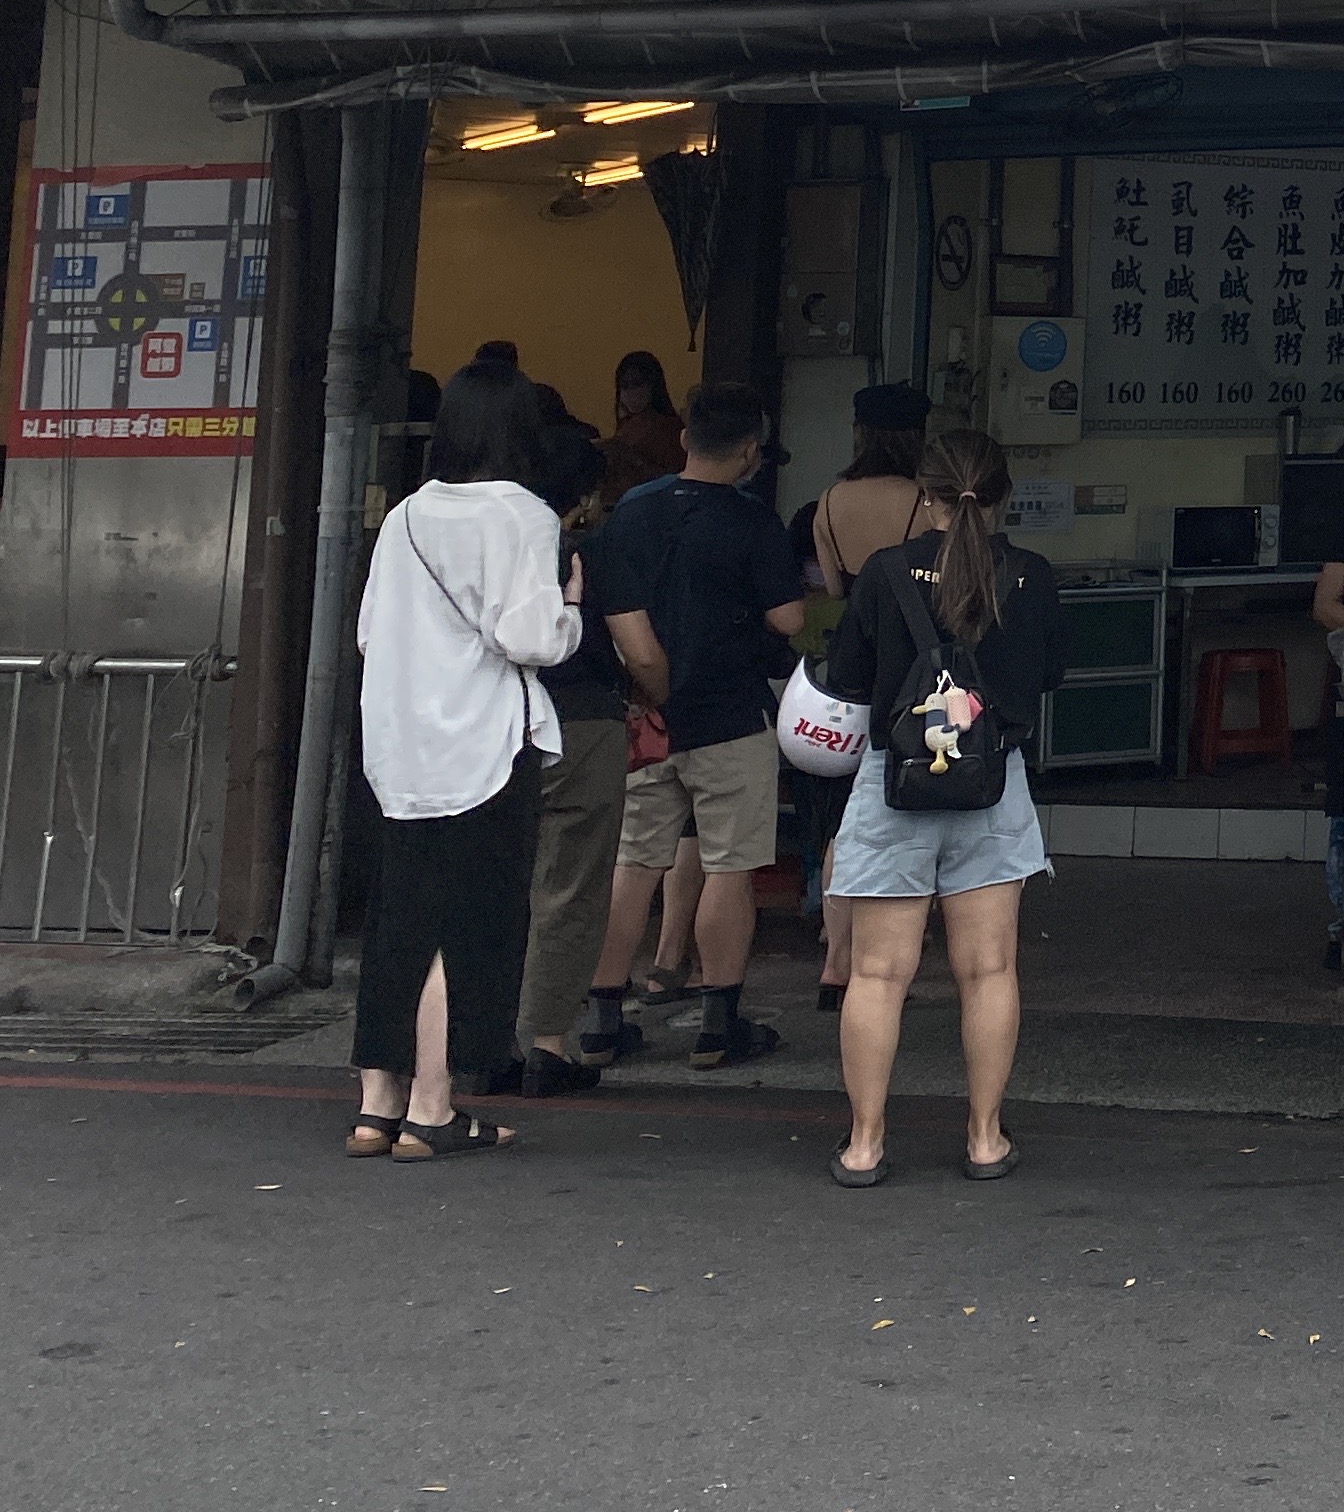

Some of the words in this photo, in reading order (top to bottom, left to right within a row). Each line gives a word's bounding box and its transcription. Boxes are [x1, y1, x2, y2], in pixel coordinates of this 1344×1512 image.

[1219, 184, 1255, 346] 綜合鹹粥
[1272, 185, 1308, 367] 魚肚加鹹粥
[1106, 381, 1146, 405] 160
[1160, 381, 1199, 405] 160
[1216, 381, 1253, 405] 160
[1267, 381, 1306, 405] 260
[794, 718, 866, 755] iRent
